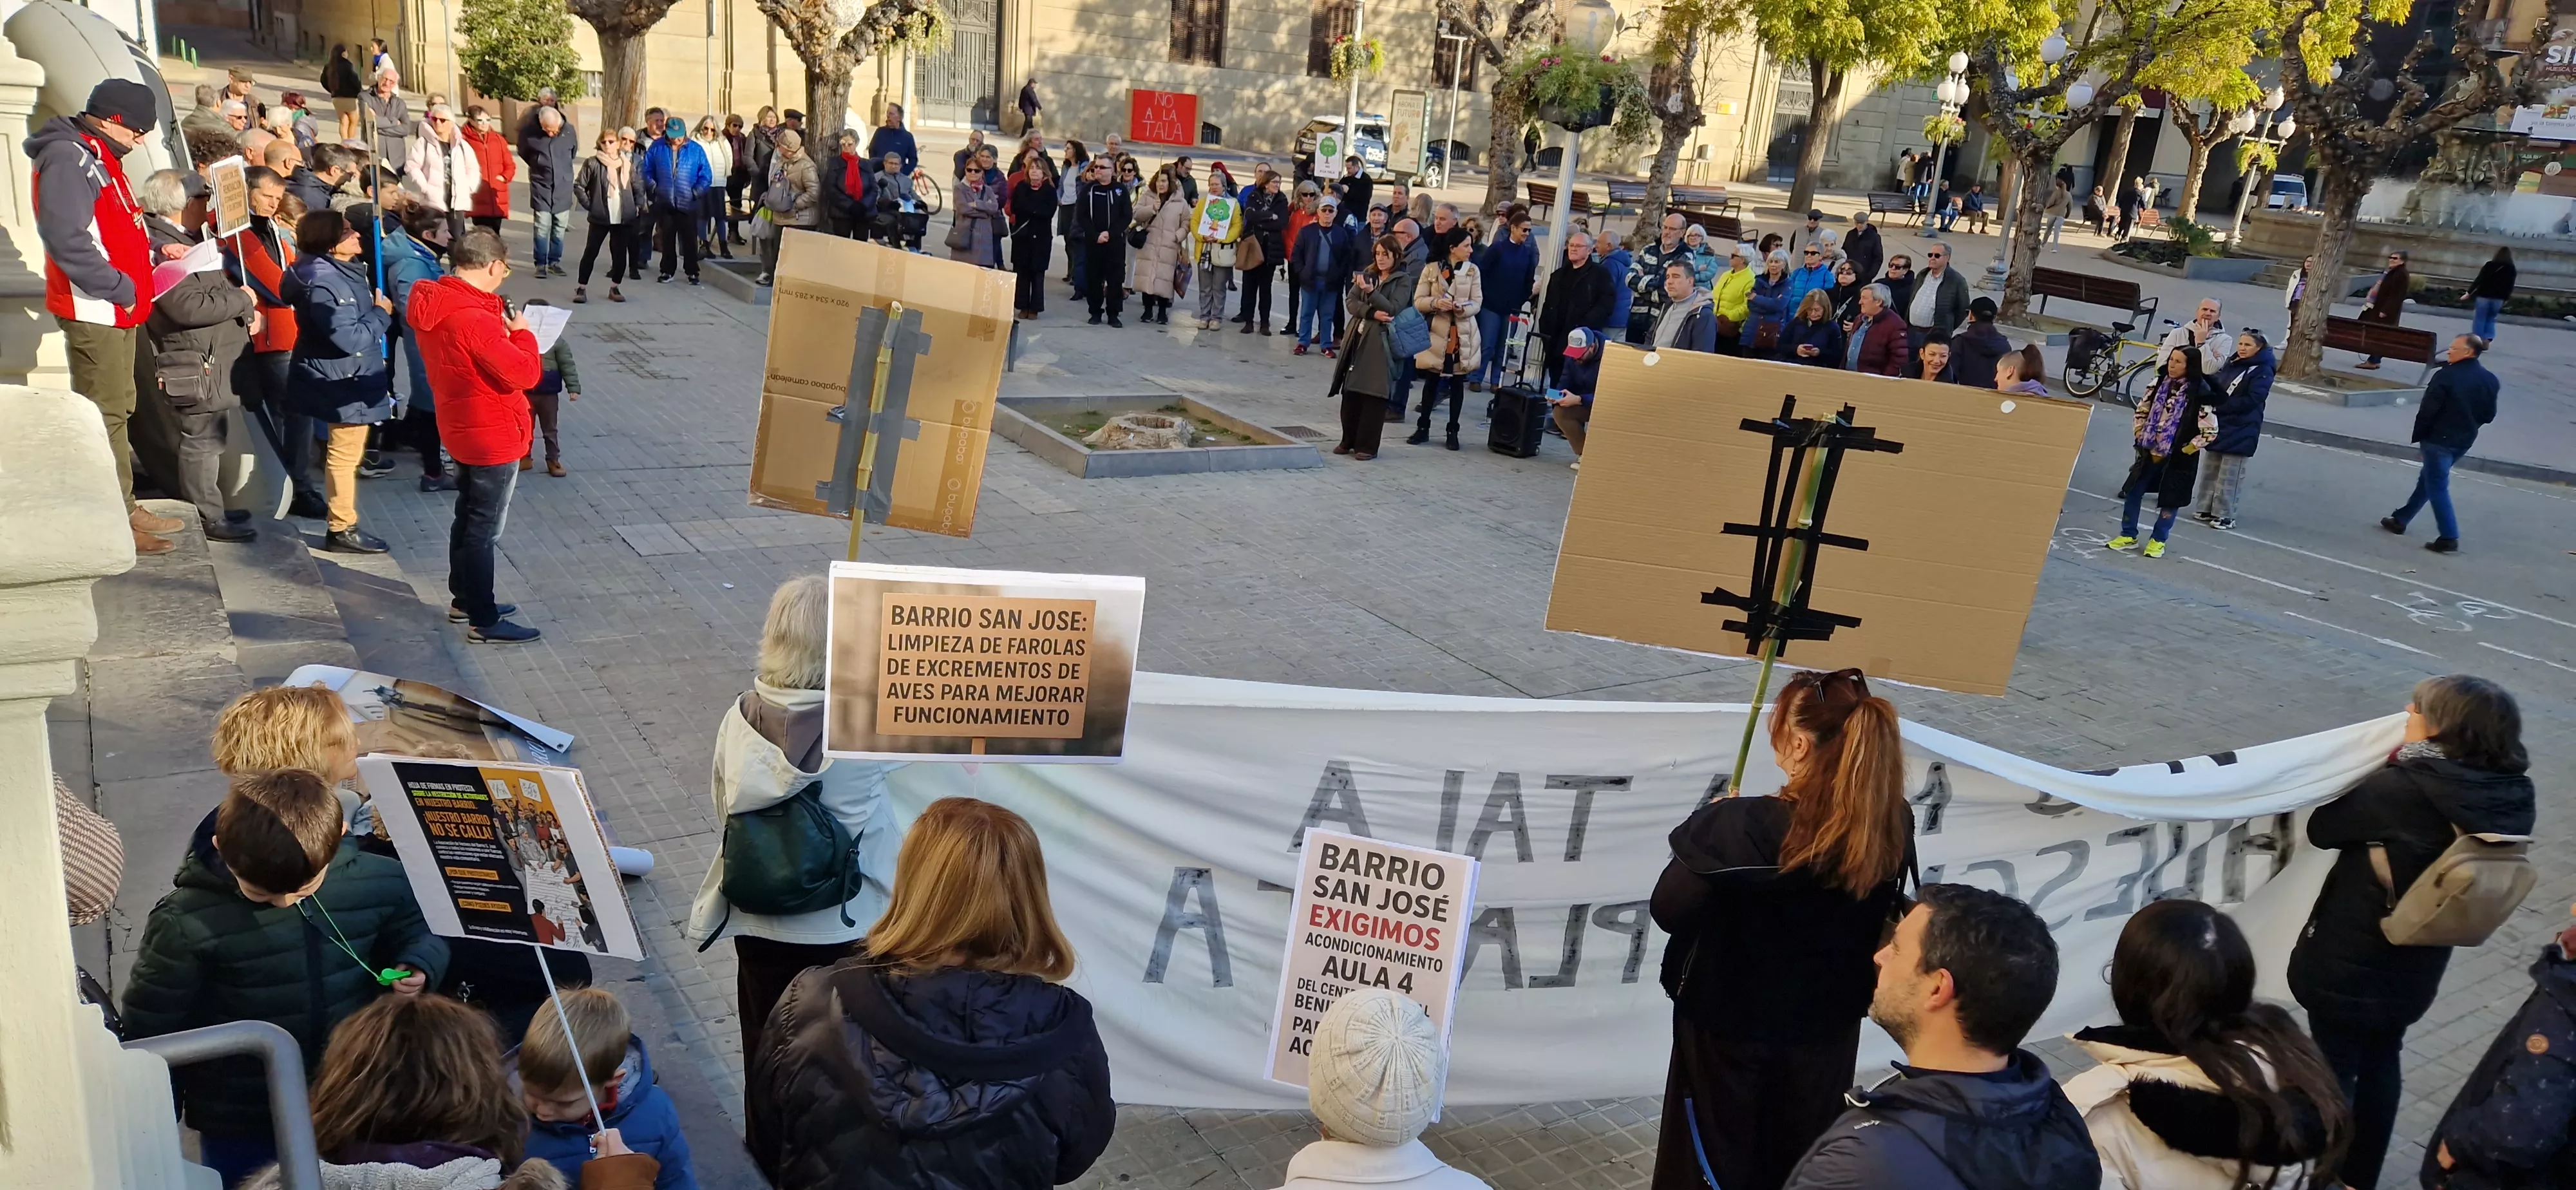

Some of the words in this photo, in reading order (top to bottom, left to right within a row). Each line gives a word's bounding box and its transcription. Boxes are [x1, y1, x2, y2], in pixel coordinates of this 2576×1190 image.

[1155, 93, 1173, 108] NO
[1145, 108, 1152, 120] A
[1163, 109, 1177, 122] LA
[1397, 109, 1421, 118] FUTURO
[1142, 120, 1183, 142] TALA
[779, 288, 793, 296] mm
[795, 291, 808, 299] 285
[837, 299, 850, 308] 920
[810, 381, 847, 393] bugaboo
[891, 605, 972, 628] BARRIO
[979, 608, 1022, 630] SAN
[1028, 610, 1088, 632] JOSE:
[888, 634, 974, 654] LIMPIEZA
[980, 637, 1003, 655] DE
[1007, 638, 1086, 657] FAROLAS
[887, 658, 911, 676] DE
[916, 659, 1052, 679] EXCREMENTOS
[1058, 663, 1081, 680] DE
[886, 683, 935, 701] AVES
[940, 684, 990, 702] PARA
[996, 685, 1084, 704] MEJORAR
[893, 706, 1070, 726] FUNCIONAMIENTO
[414, 797, 425, 806] EN
[424, 798, 453, 808] NUESTRO
[422, 811, 462, 824] ¡NUESTRO
[460, 813, 491, 826] BARRIO
[429, 822, 446, 836] NO
[444, 824, 461, 838] SE
[459, 824, 495, 840] CALLA!
[1319, 843, 1445, 891] BARRIO
[1312, 875, 1370, 907] SAN
[1376, 888, 1450, 923] JOSÉ
[1309, 903, 1441, 952] EXIGIMOS
[1305, 932, 1444, 974] ACONDICIONAMIENTO
[1321, 956, 1391, 990] AULA
[1397, 972, 1414, 996] 4
[1298, 978, 1318, 992] DEL
[1320, 982, 1356, 998] CENT
[1294, 993, 1336, 1013] BENI
